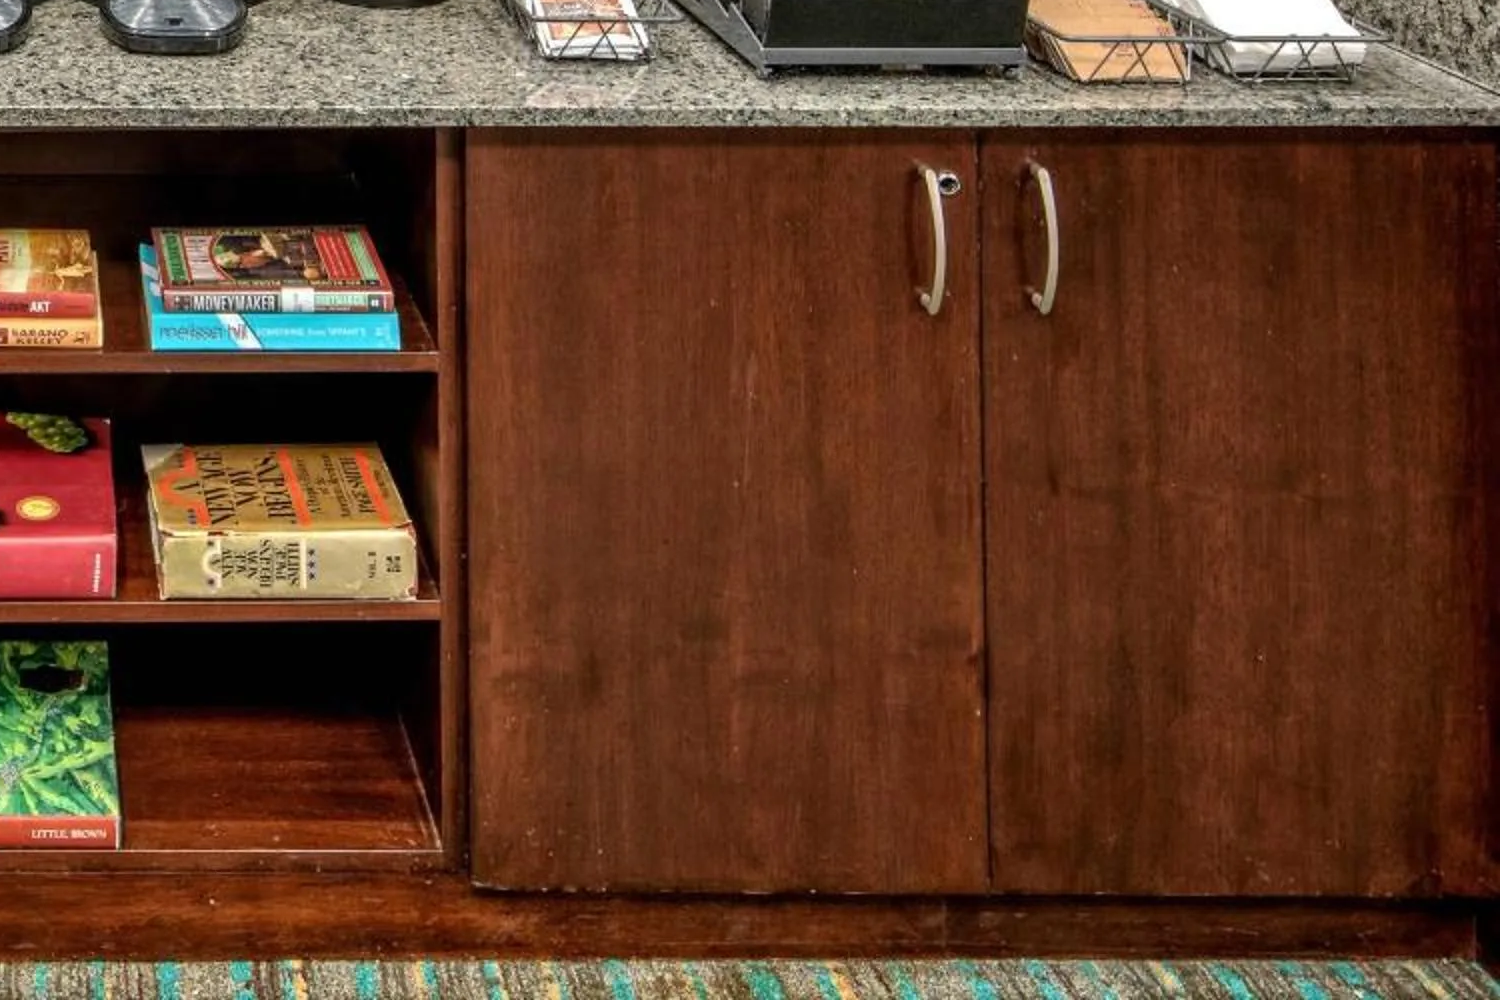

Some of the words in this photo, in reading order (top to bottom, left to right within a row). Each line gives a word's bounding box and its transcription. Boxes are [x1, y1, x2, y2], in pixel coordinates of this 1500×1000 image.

[29, 301, 52, 313] AKT
[193, 294, 276, 312] MONEYMAKER
[259, 539, 272, 588] BEGINS
[71, 828, 107, 839] BROWN
